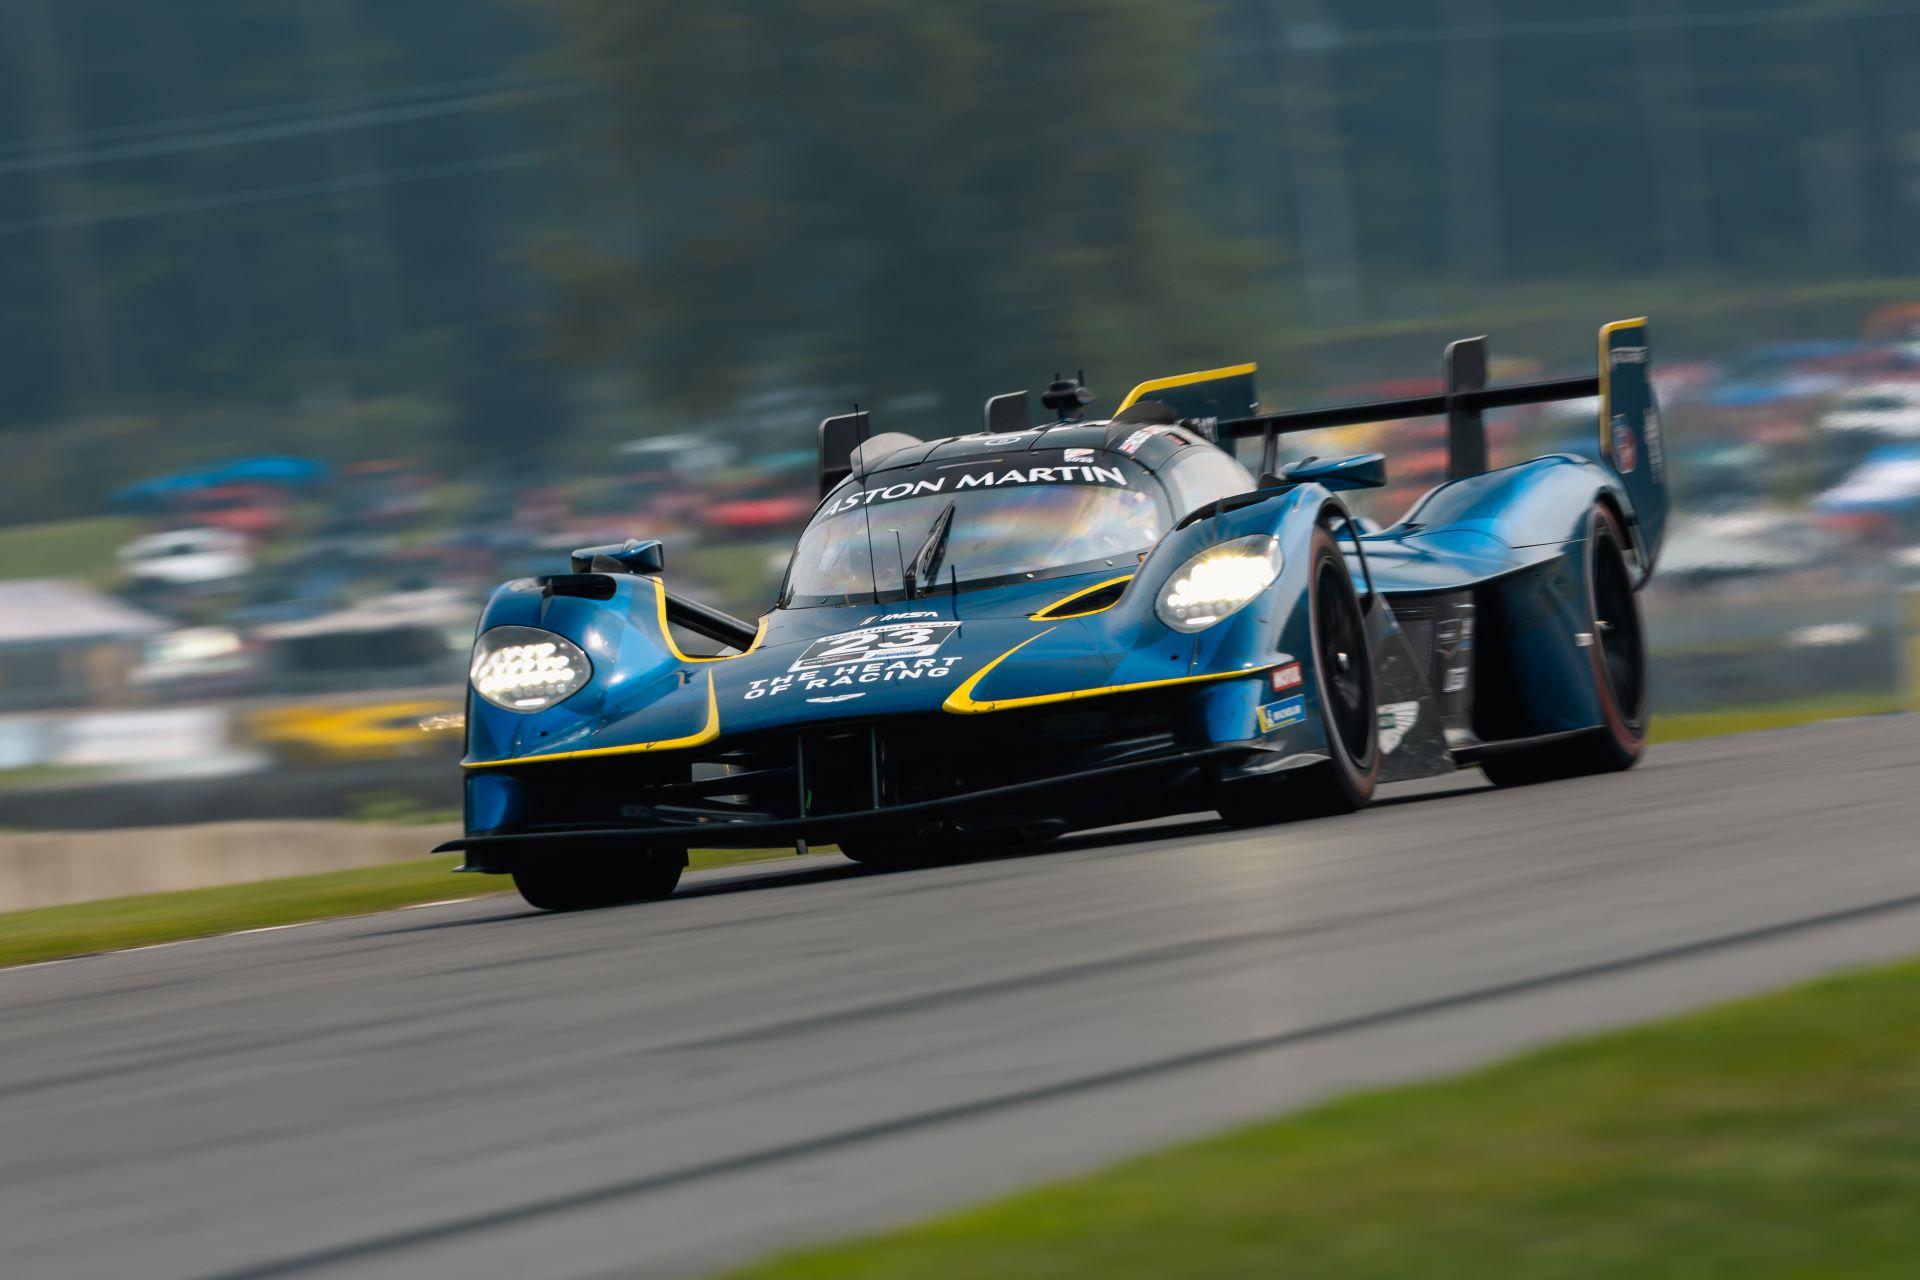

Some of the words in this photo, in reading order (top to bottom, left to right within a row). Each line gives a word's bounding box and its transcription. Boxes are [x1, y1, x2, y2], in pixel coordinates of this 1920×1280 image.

[820, 477, 945, 520] ASTON
[955, 466, 1127, 488] MARTIN
[880, 611, 939, 622] IMSA
[817, 627, 934, 658] 23
[744, 684, 792, 699] OF
[805, 667, 951, 690] RACING
[749, 671, 820, 689] THE
[834, 656, 963, 676] HEART
